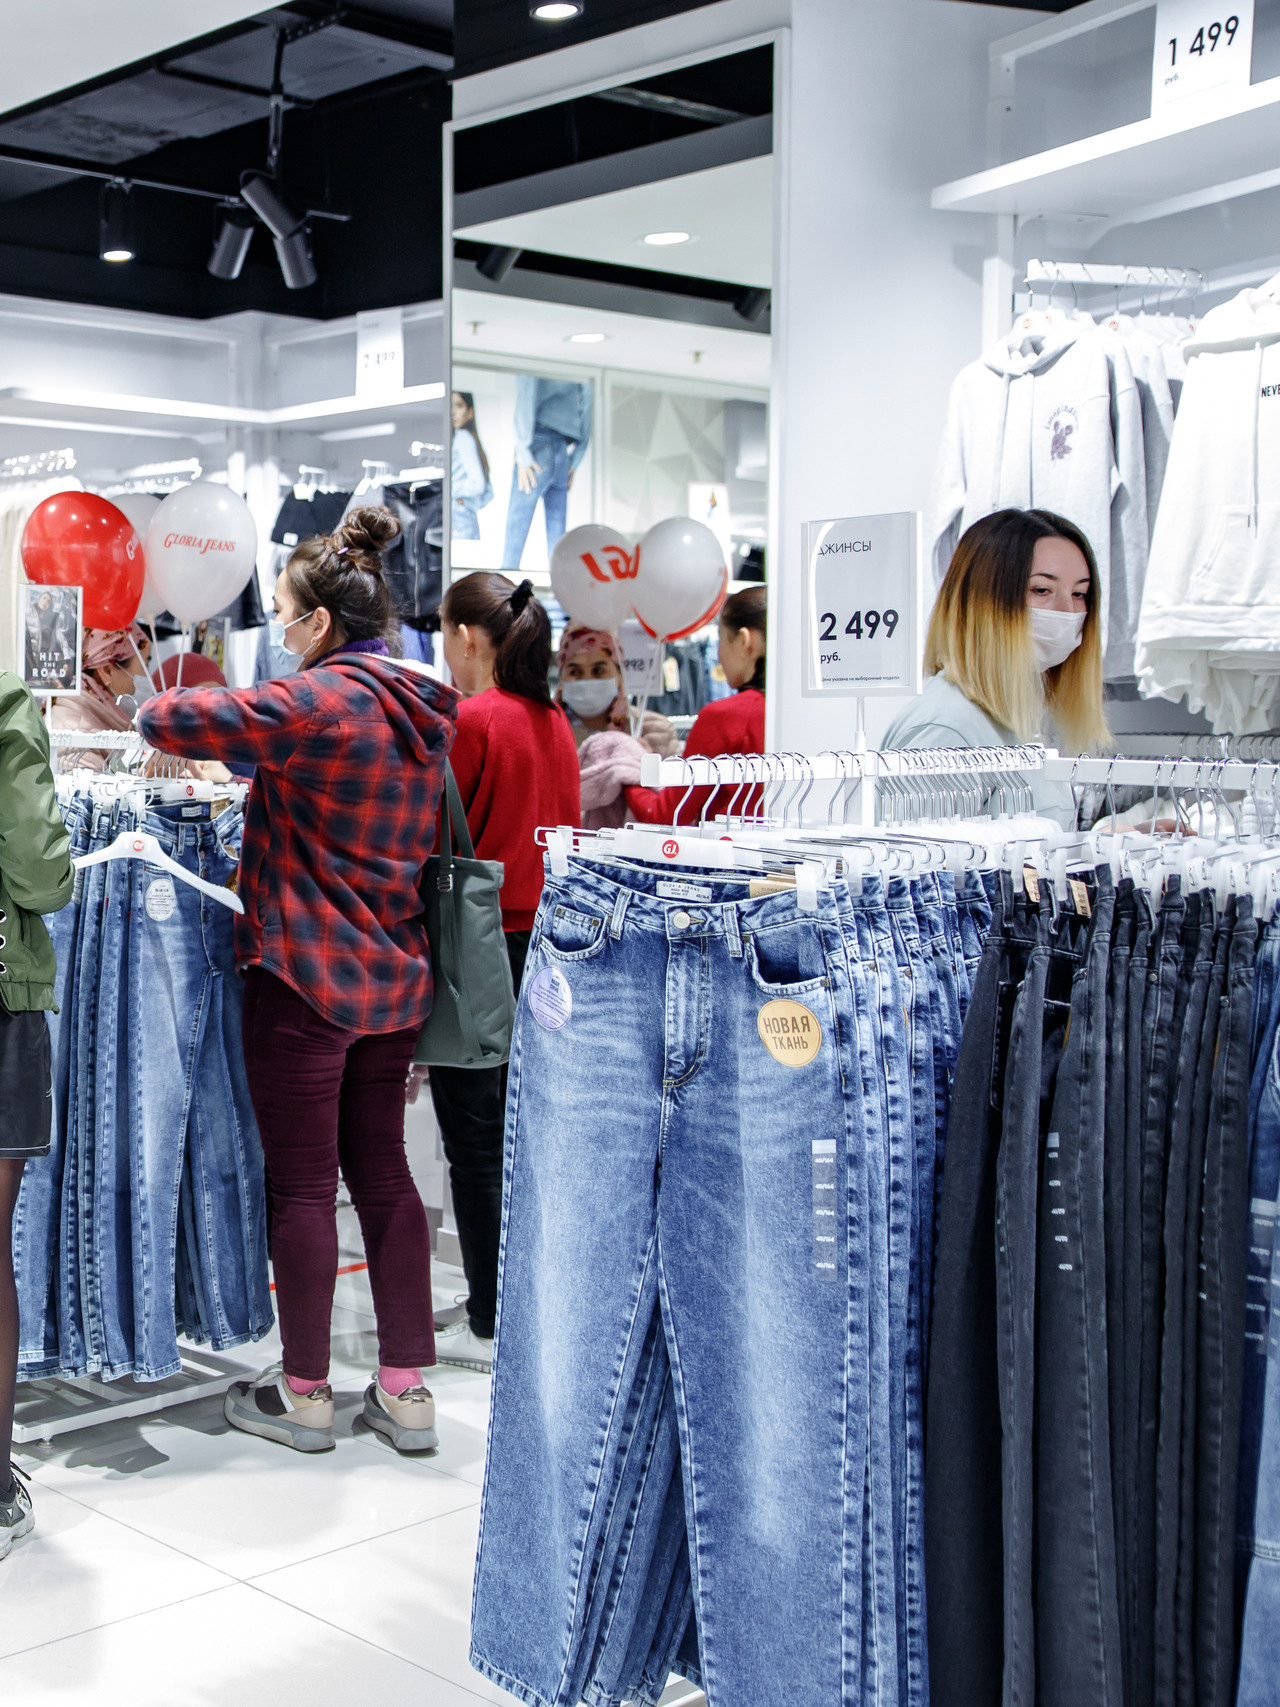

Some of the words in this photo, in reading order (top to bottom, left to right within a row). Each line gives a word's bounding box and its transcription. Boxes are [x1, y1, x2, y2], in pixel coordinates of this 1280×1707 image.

[1168, 37, 1177, 66] 1
[1189, 15, 1239, 56] 499
[163, 533, 202, 548] GLORIA
[200, 539, 236, 554] JEANS
[820, 612, 837, 641] 2
[845, 609, 899, 639] 499
[40, 652, 60, 661] HIT
[821, 652, 841, 664] руб.
[32, 668, 66, 678] ROAD
[763, 1015, 811, 1034] НОВАЯ
[772, 1036, 809, 1050] ТКАНЬ
